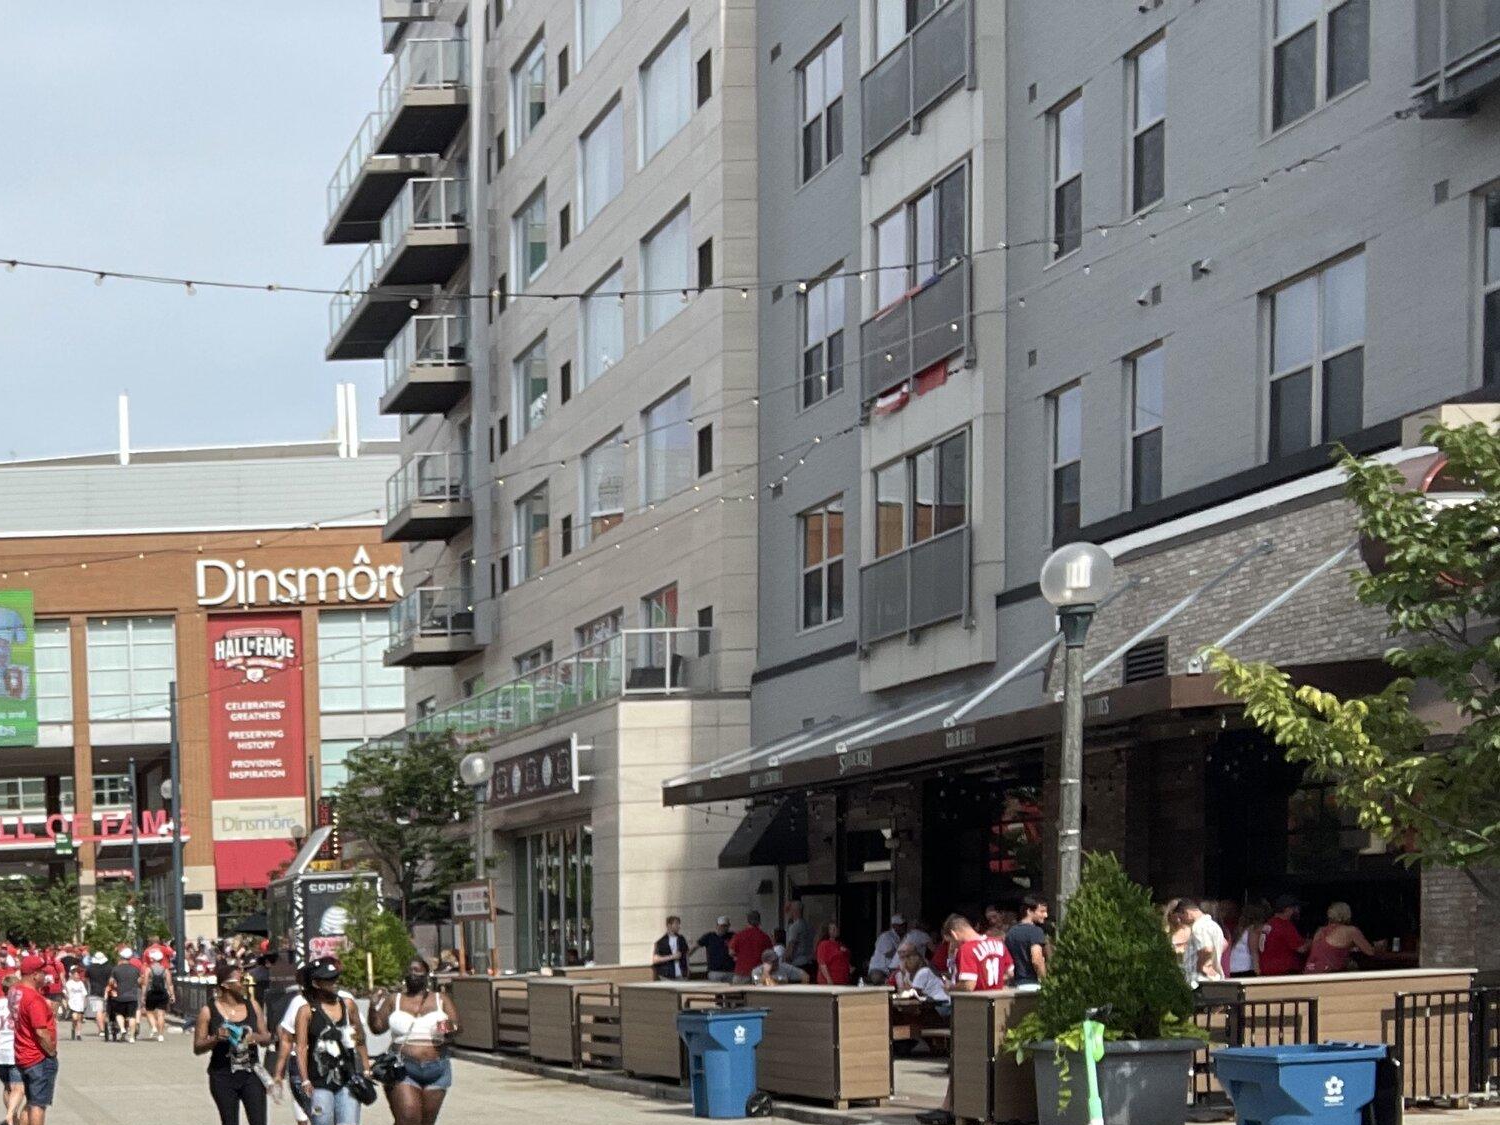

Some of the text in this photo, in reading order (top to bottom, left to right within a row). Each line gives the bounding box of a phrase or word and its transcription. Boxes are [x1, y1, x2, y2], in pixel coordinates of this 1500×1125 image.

[215, 636, 252, 660] HALL
[257, 635, 295, 659] FAME
[225, 701, 286, 711] CELEBRATING
[230, 711, 281, 721] GREATNESS
[228, 730, 284, 740] PRESERVING
[237, 741, 275, 750] HISTORY
[231, 759, 282, 769] PROVIDING
[229, 770, 286, 780] INSPIRATION
[46, 813, 92, 840] OF
[986, 957, 1000, 986] 11
